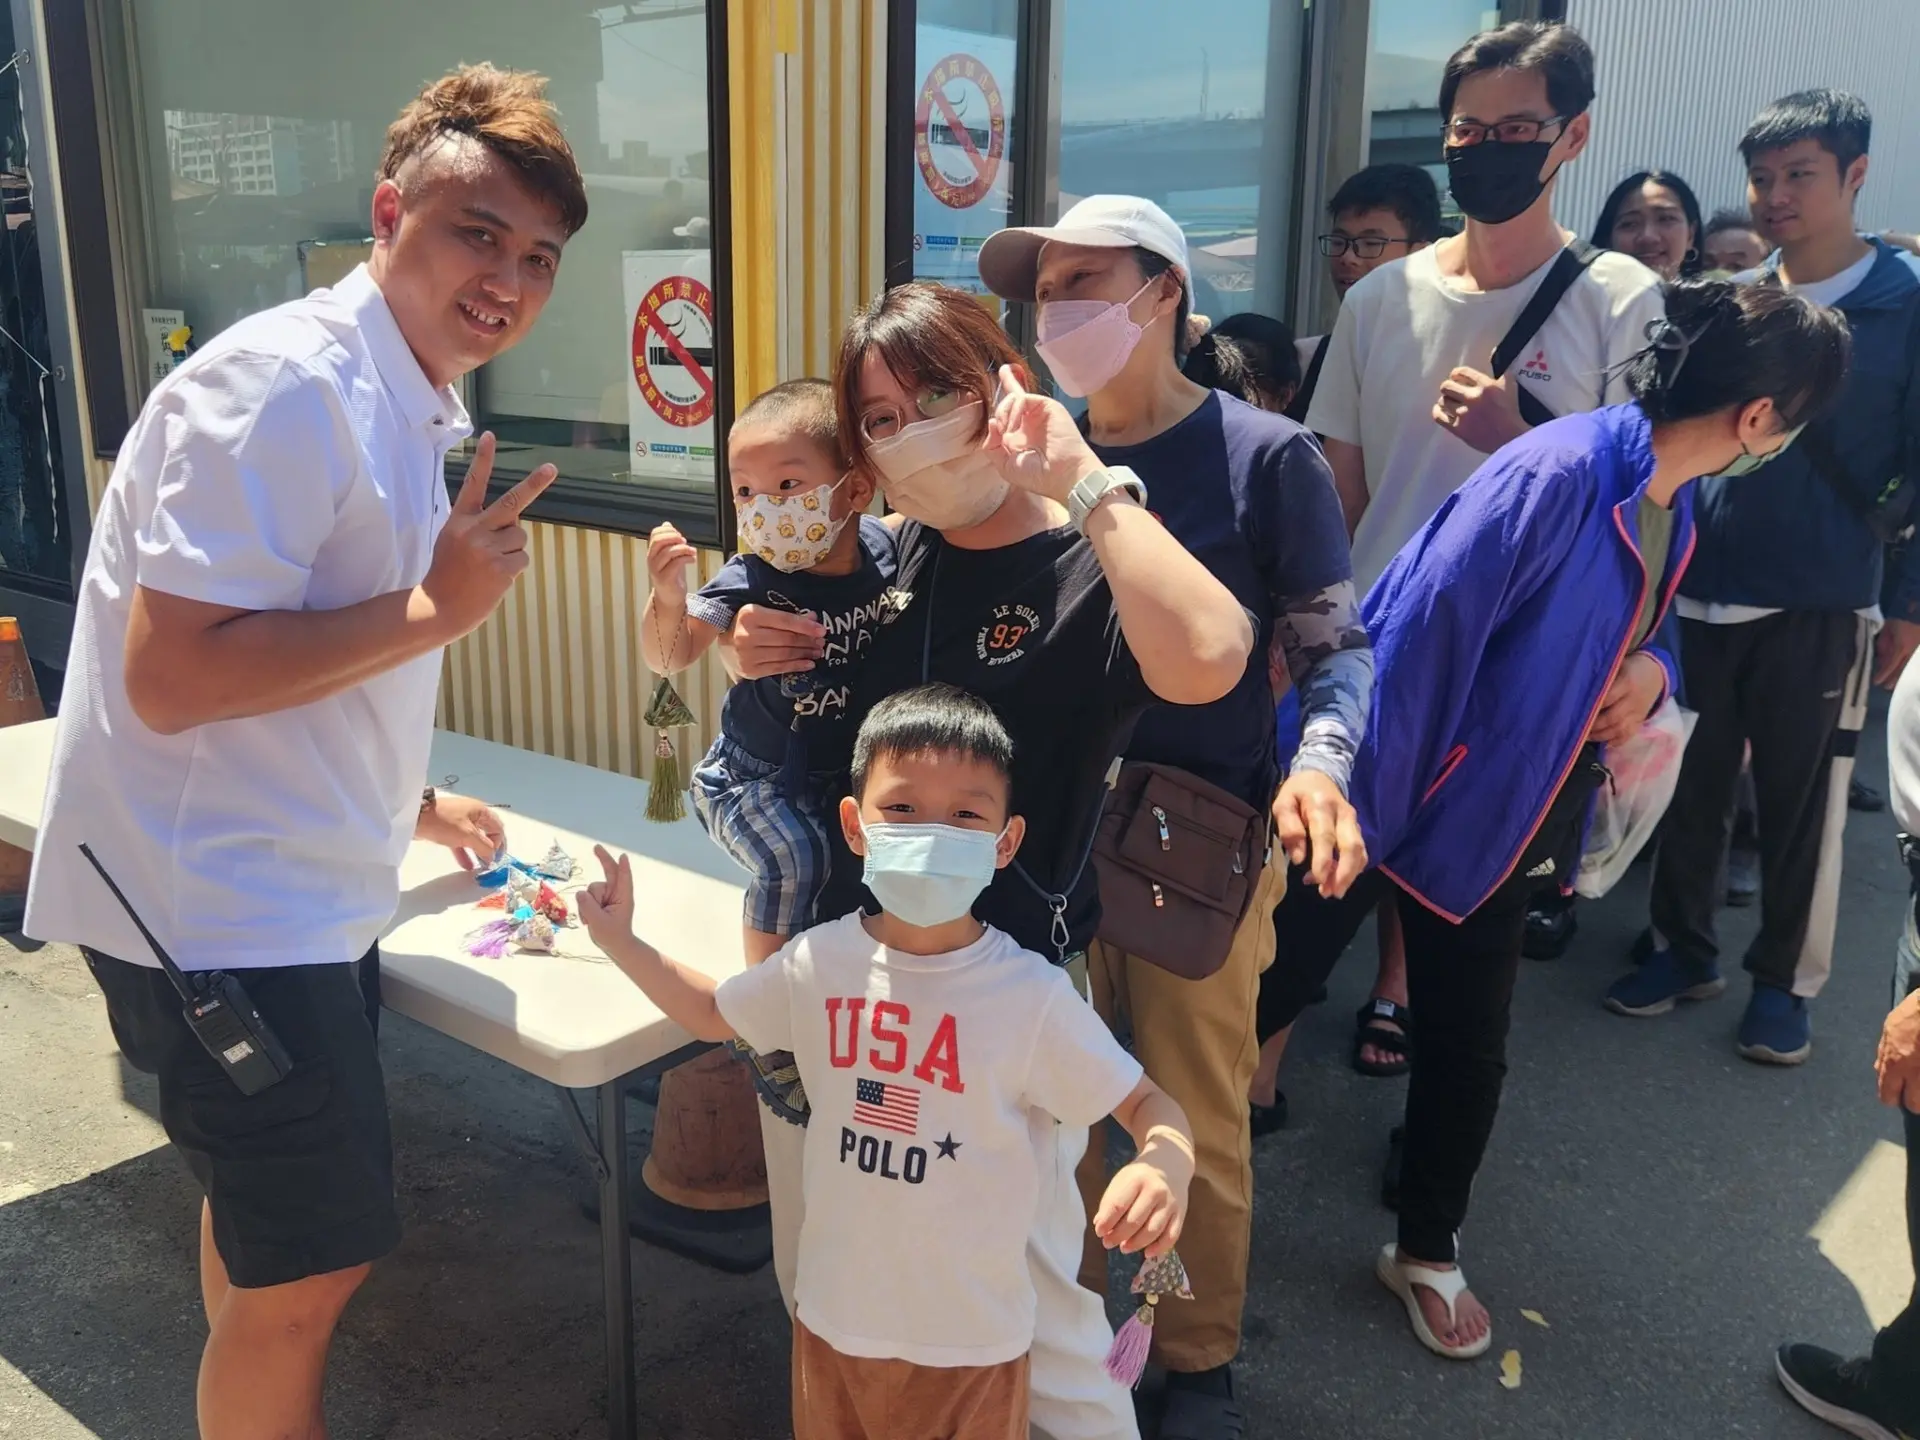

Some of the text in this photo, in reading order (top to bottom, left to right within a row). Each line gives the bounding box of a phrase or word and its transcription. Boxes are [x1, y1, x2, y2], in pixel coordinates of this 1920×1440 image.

[638, 282, 712, 329] 本場所禁止
[1518, 369, 1552, 382] FUSO
[993, 605, 1010, 619] LE
[987, 648, 1025, 666] RIVIERA
[825, 997, 965, 1094] USA
[840, 1126, 927, 1184] POLO
